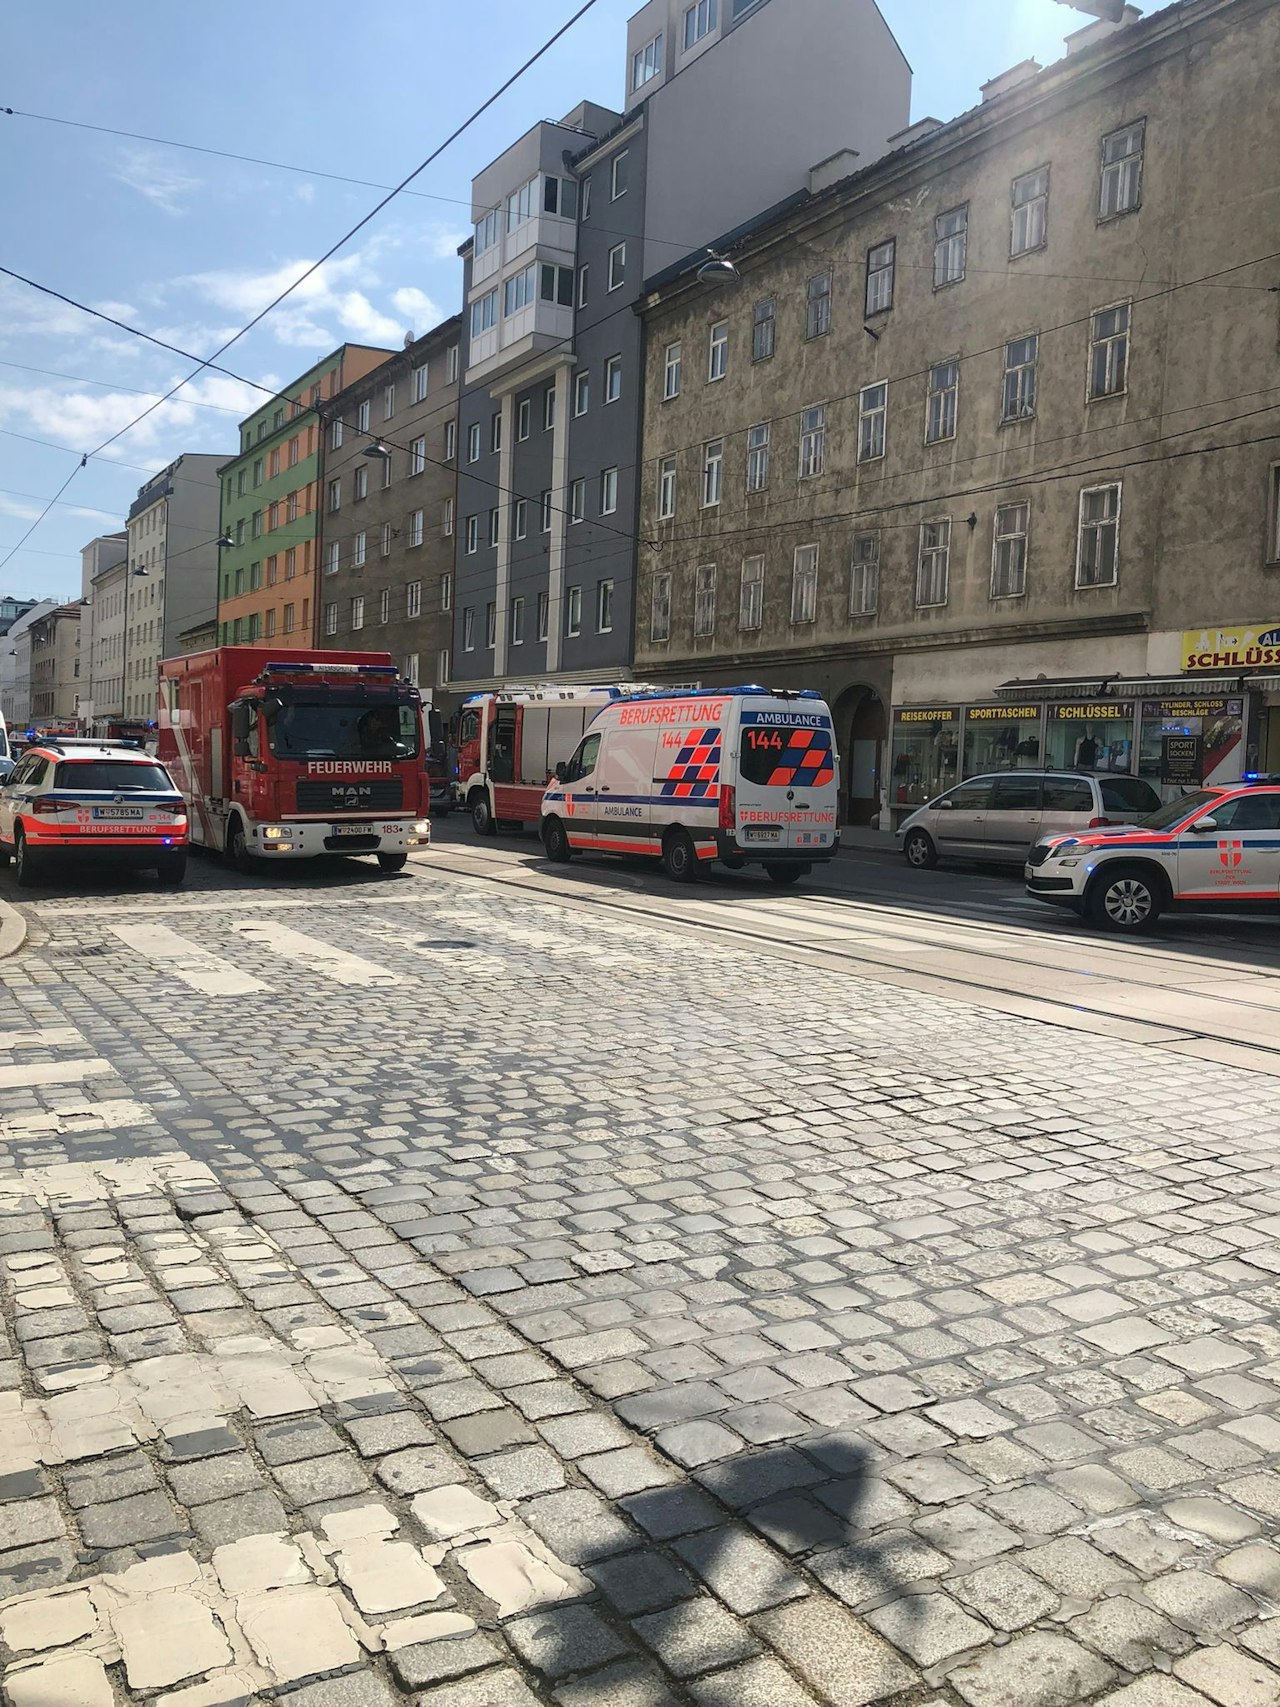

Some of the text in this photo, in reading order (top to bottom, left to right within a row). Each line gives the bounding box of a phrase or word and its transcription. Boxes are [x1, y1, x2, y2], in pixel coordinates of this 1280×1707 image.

[1161, 701, 1192, 709] ZYLINDER,
[1194, 700, 1223, 708] SCHLOSS
[620, 704, 722, 725] BERUFSRETTUNG
[901, 711, 952, 721] REISEKOFFER
[969, 707, 1037, 719] SPORTTASCHEN
[1059, 703, 1121, 718] SCHLÜSSEL
[1172, 707, 1209, 716] BESCHLÄGE
[756, 713, 821, 726] AMBULANCE
[662, 732, 682, 748] 144
[747, 730, 783, 750] 144
[1170, 741, 1194, 749] SPORT
[307, 761, 392, 774] FEUERWEHR
[331, 787, 372, 796] MAN
[604, 806, 642, 817] AMBULANCE
[749, 811, 834, 823] BERUFSRETTUNG
[80, 825, 157, 833] BERUFSRETTUNG
[381, 825, 399, 834] 183
